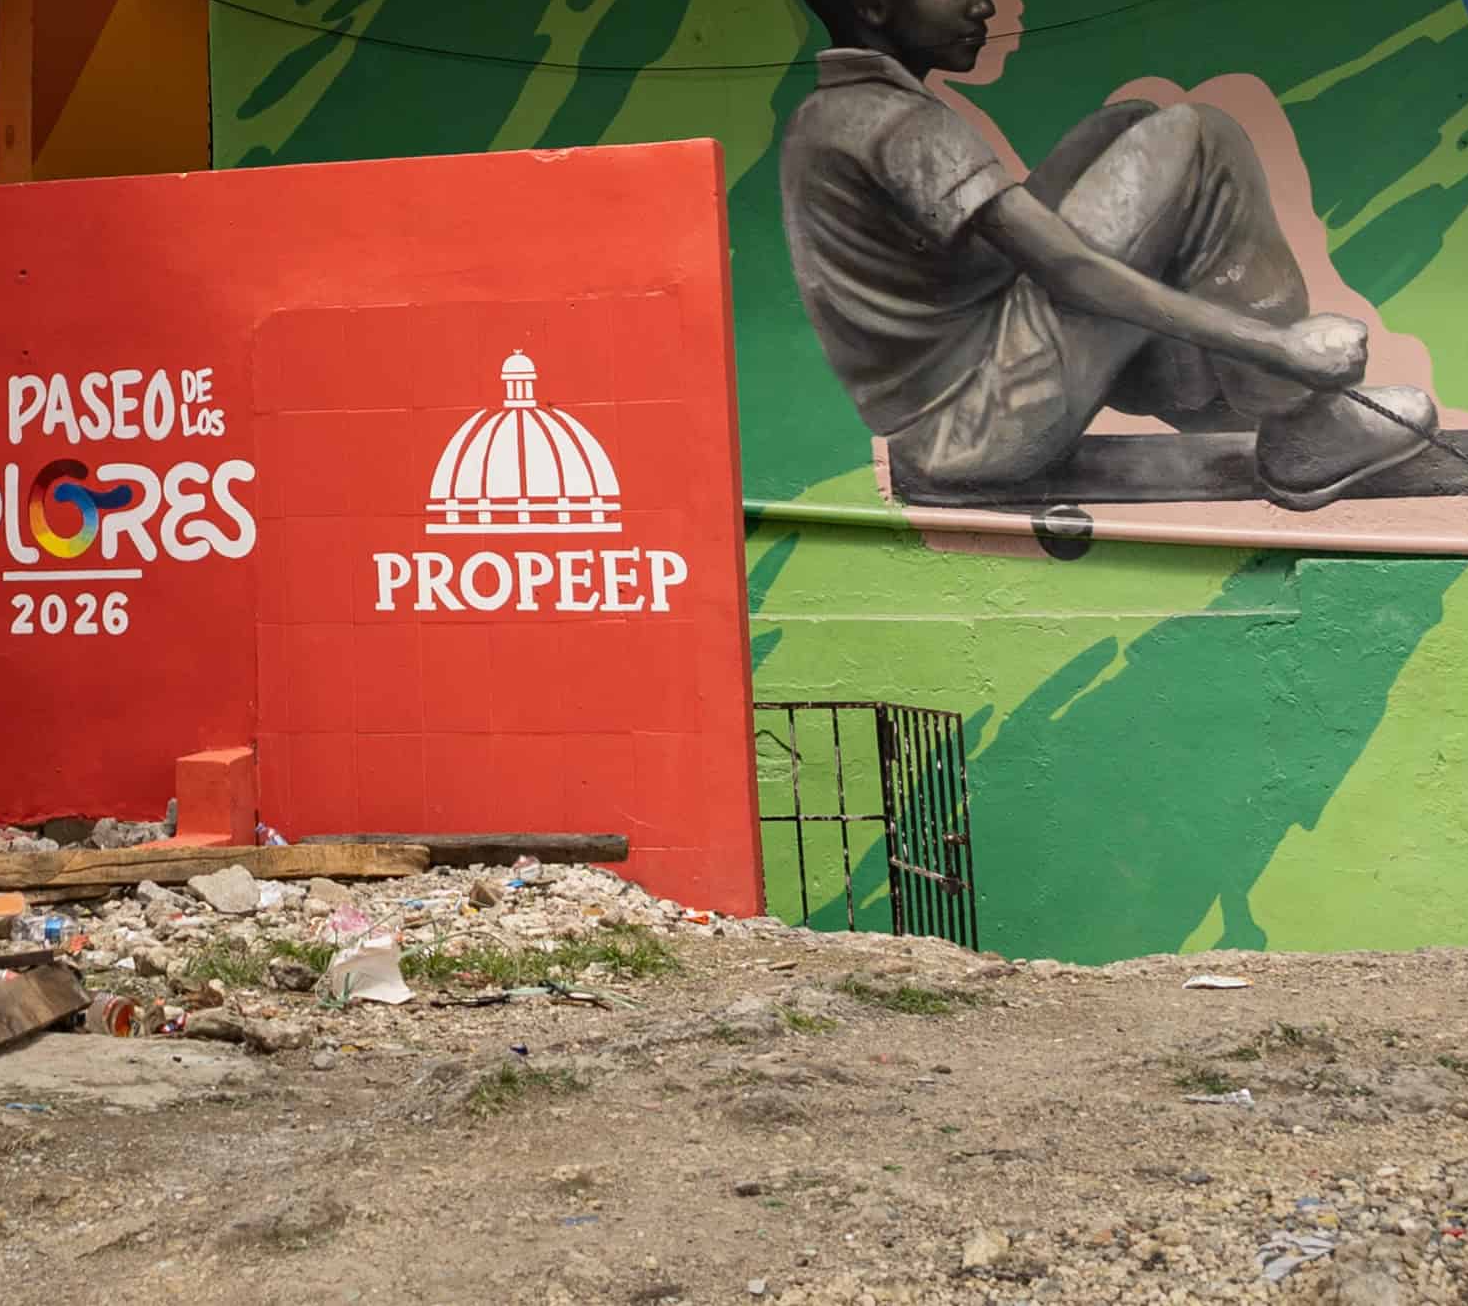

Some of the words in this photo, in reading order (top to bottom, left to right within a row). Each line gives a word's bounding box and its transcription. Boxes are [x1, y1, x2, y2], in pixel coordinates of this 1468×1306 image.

[7, 368, 176, 444] PASEO
[180, 367, 214, 404] DE
[179, 402, 226, 438] LOS
[371, 546, 689, 613] PROPEEP
[9, 590, 130, 636] 2026
